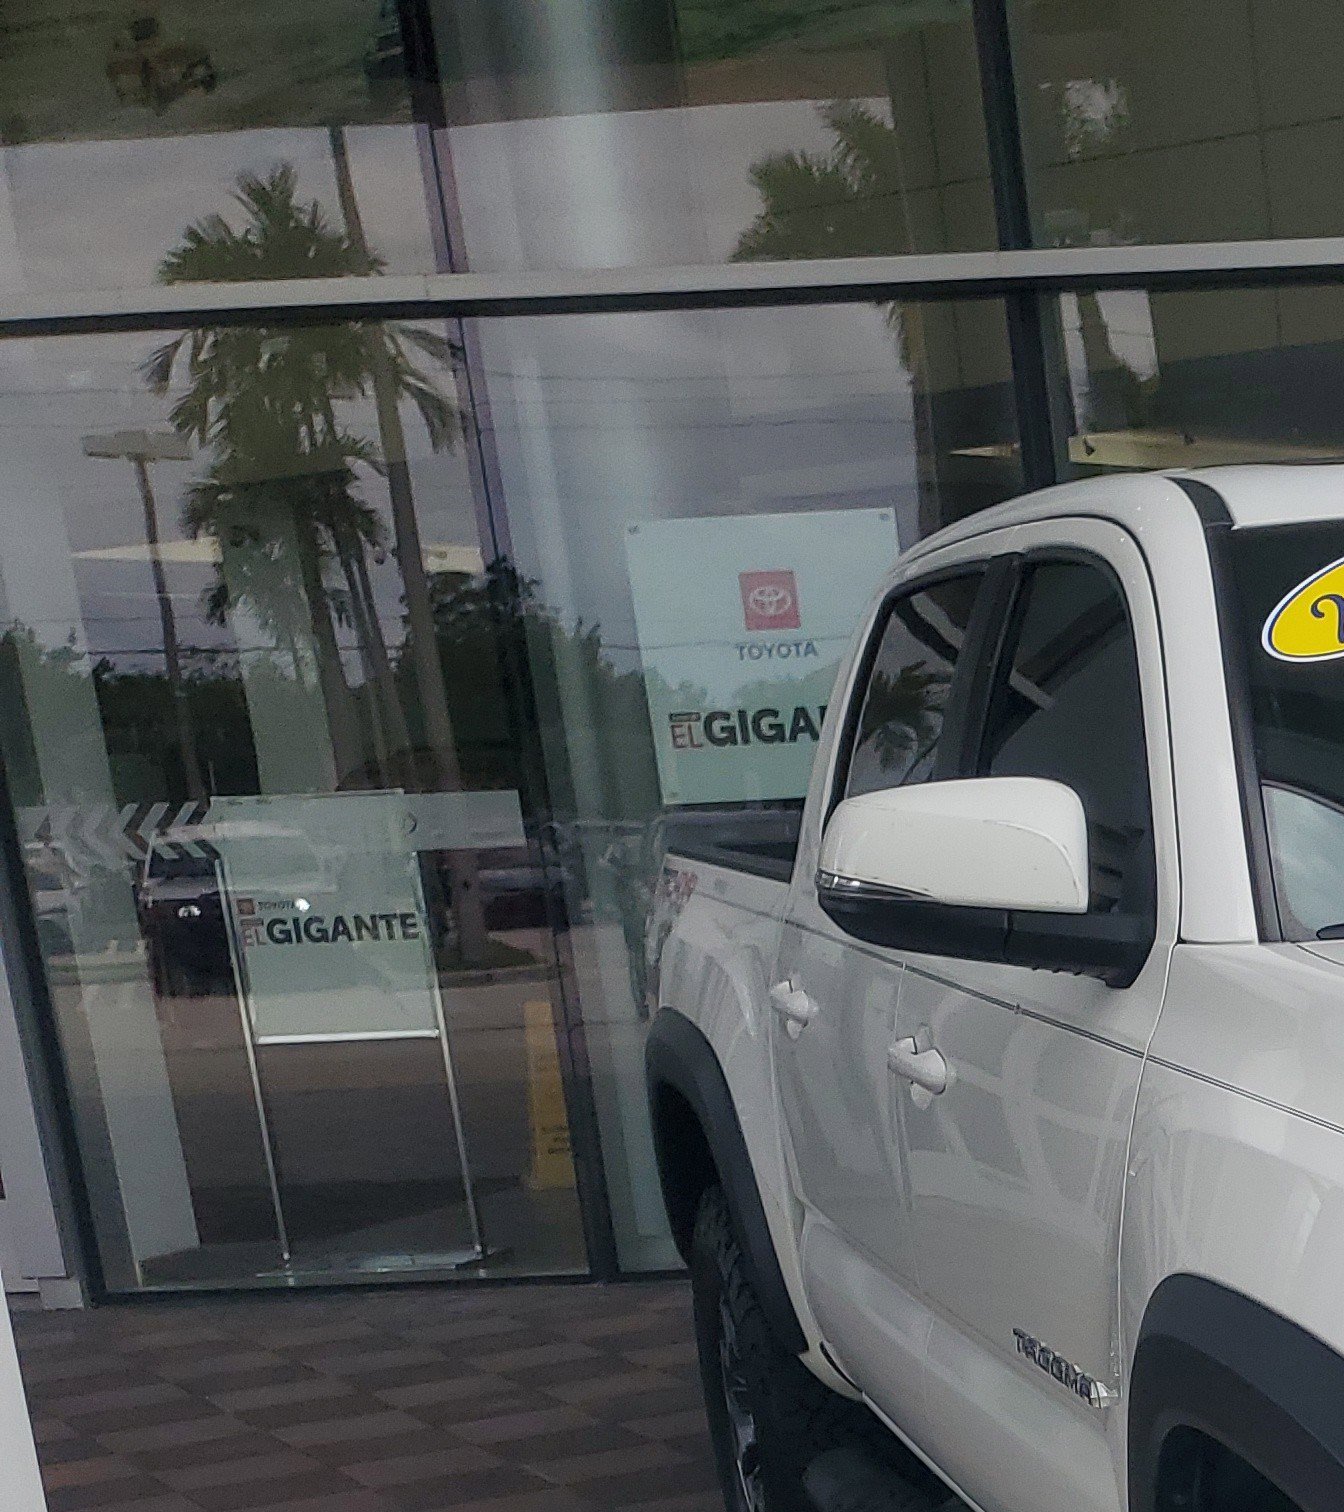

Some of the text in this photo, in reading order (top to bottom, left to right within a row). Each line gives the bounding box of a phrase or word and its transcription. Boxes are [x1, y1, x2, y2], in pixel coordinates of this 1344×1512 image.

[736, 641, 818, 662] TOYOTA
[670, 723, 703, 749] EL
[266, 912, 420, 945] GIGANTE
